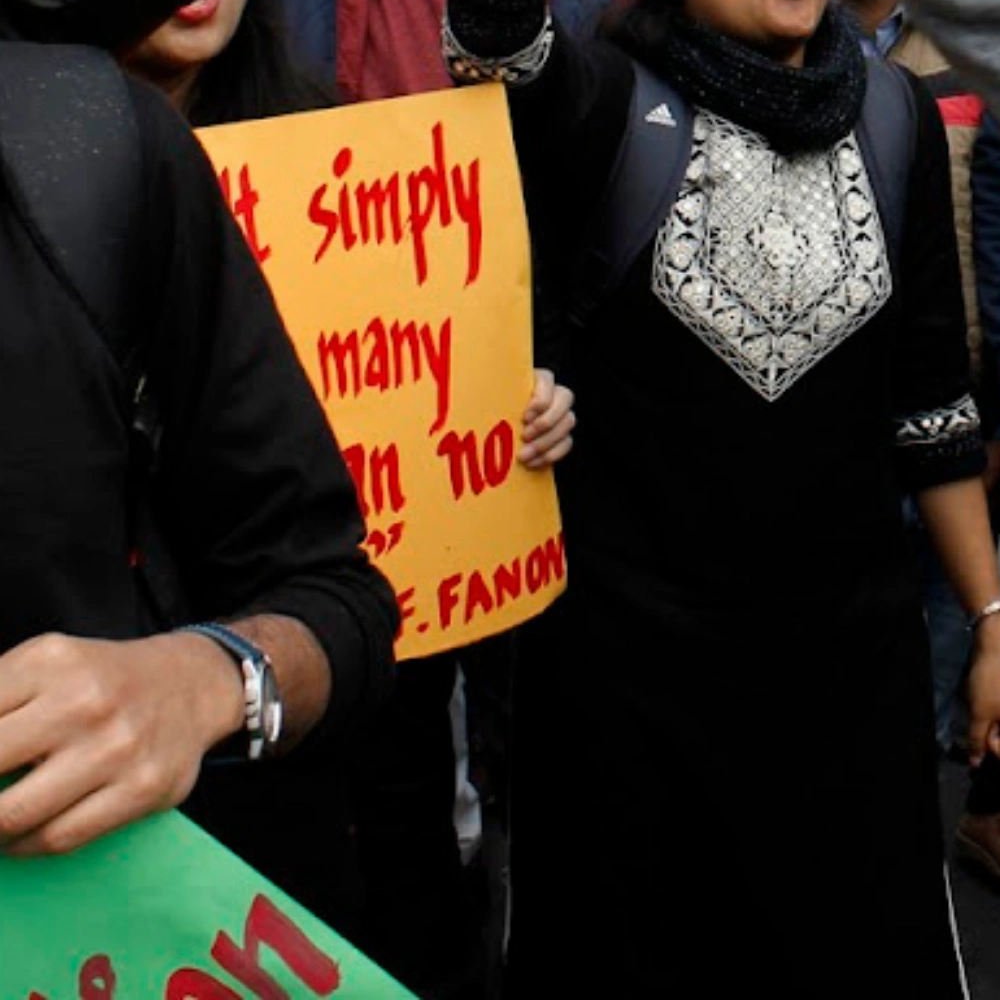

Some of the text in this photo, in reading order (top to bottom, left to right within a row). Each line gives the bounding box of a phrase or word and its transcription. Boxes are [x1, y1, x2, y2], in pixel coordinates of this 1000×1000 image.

[307, 121, 483, 287] simply
[317, 316, 452, 437] many
[436, 419, 514, 501] no
[436, 531, 566, 631] FANON
